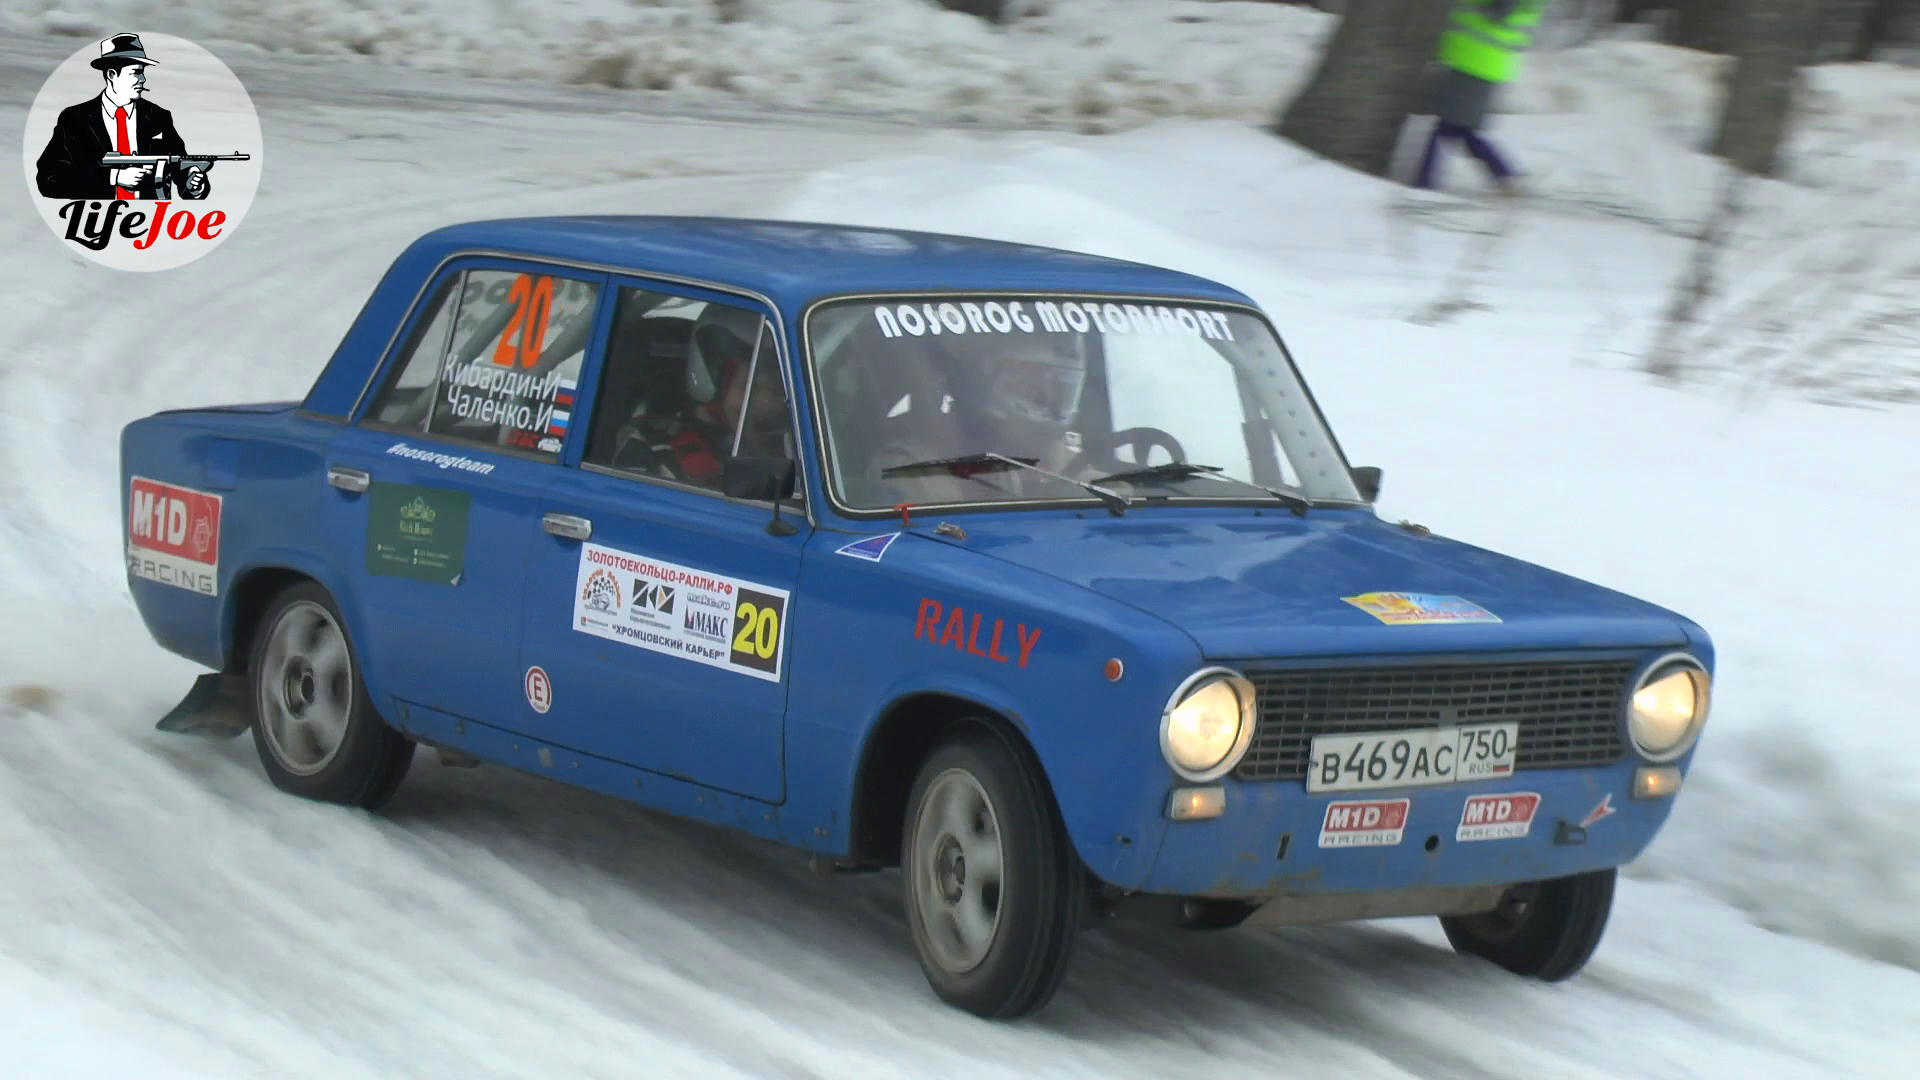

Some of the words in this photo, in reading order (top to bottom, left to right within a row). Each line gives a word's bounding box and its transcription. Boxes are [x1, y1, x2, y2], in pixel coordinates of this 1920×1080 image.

[492, 273, 553, 369] 20
[874, 302, 1034, 338] NOSOROG
[1034, 301, 1235, 342] MOTORSPORT
[133, 490, 187, 546] M1D
[733, 602, 778, 660] 20
[914, 597, 1042, 669] RALLY
[1462, 729, 1508, 762] 750
[1468, 761, 1492, 774] RUS
[1328, 806, 1381, 829] M1D
[1466, 800, 1511, 824] M1D
